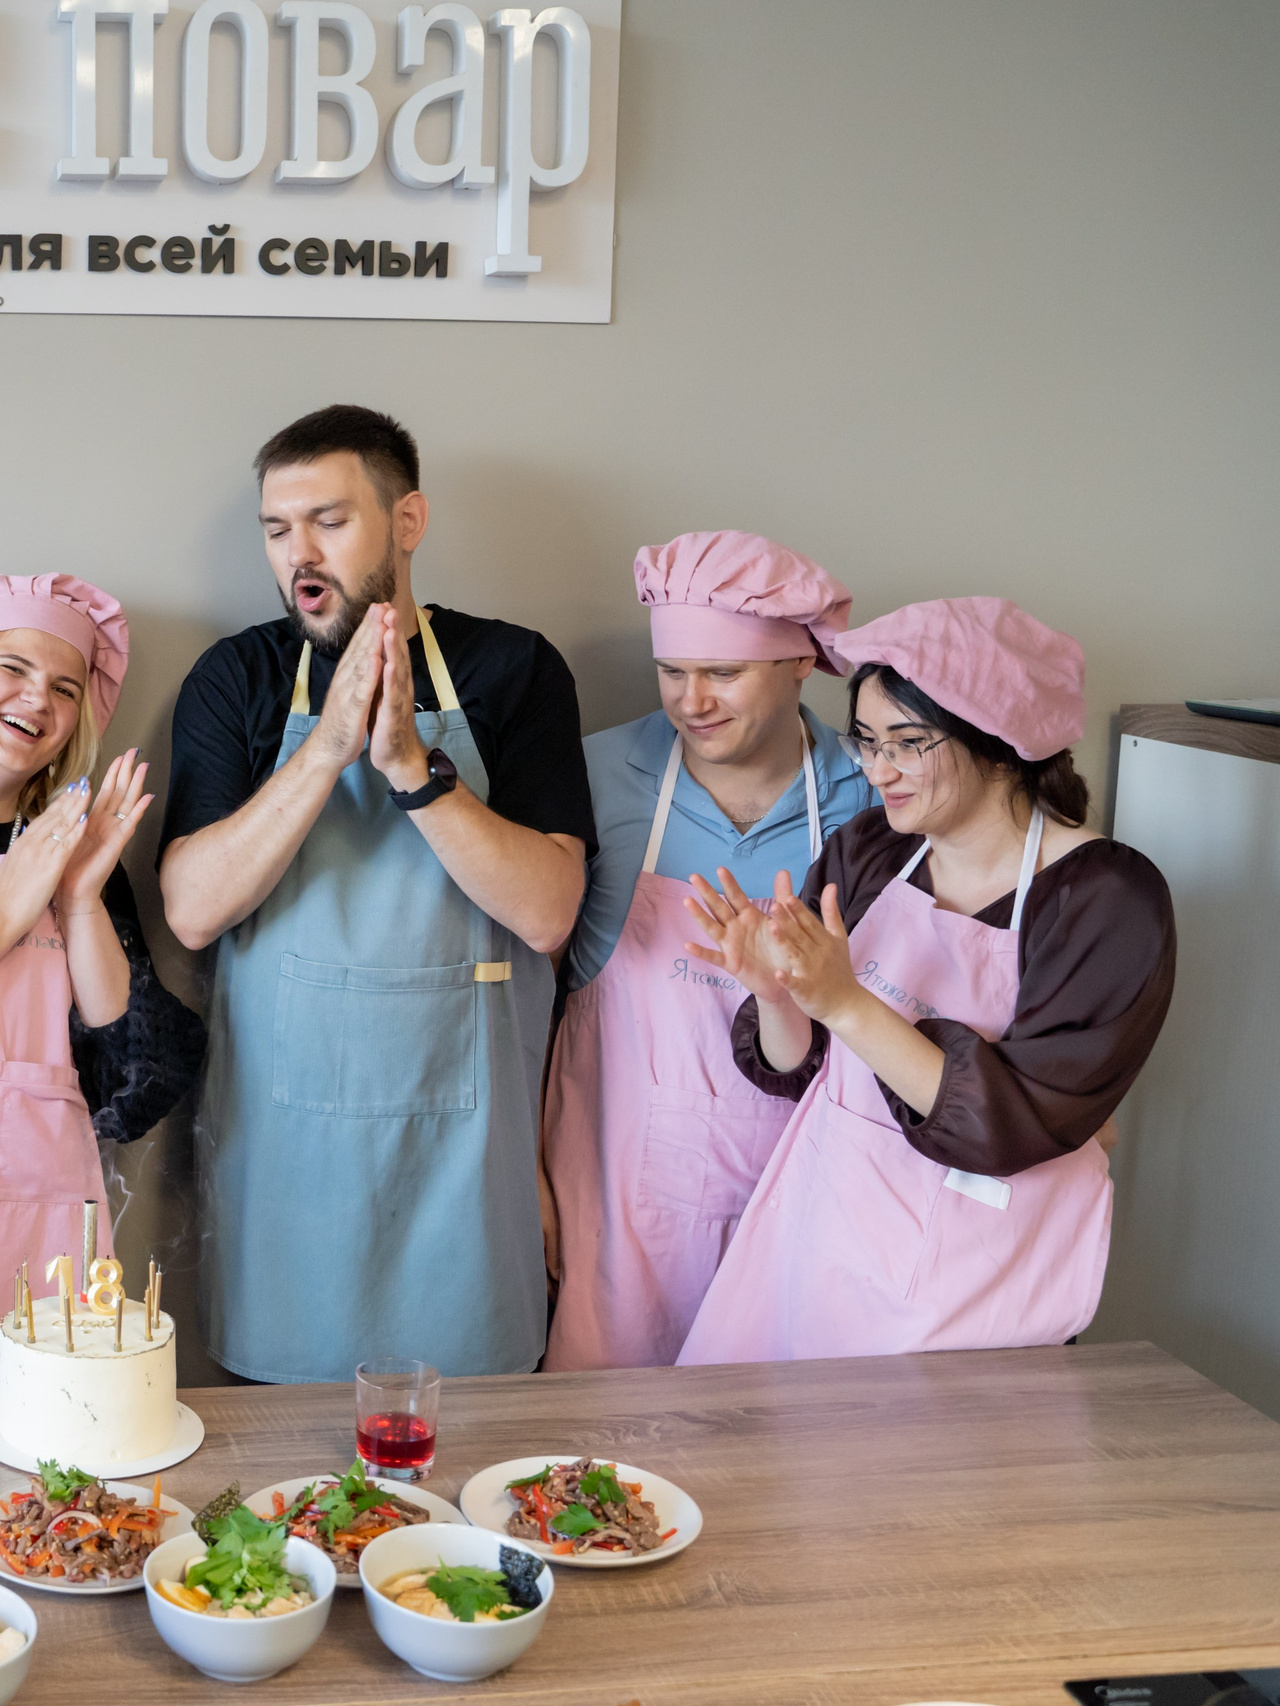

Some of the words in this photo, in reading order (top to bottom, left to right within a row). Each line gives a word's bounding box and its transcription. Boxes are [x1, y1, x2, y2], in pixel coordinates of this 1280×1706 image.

[56, 0, 591, 278] повар
[87, 224, 236, 276] всей
[258, 236, 449, 279] семьи
[669, 958, 688, 982] Я
[45, 1255, 126, 1316] 18
